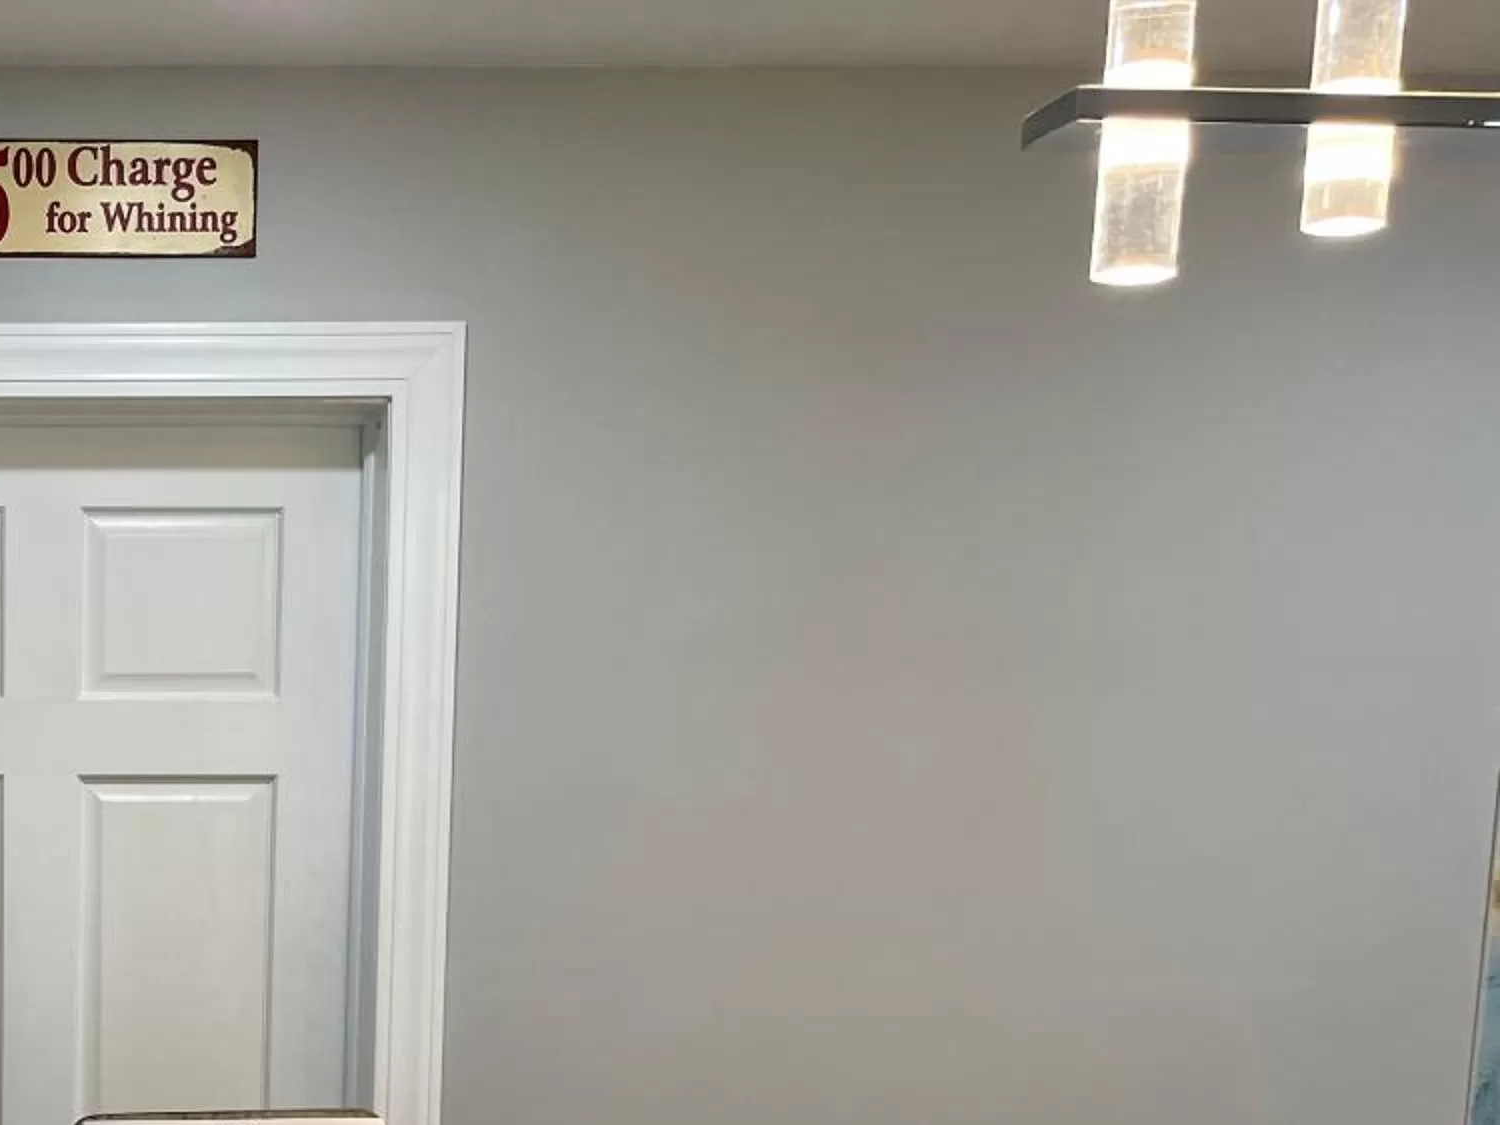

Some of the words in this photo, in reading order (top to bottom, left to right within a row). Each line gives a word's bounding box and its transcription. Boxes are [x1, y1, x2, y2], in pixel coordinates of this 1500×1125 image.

[67, 144, 218, 202] Charge
[45, 202, 93, 233] for
[101, 202, 238, 242] Whining
